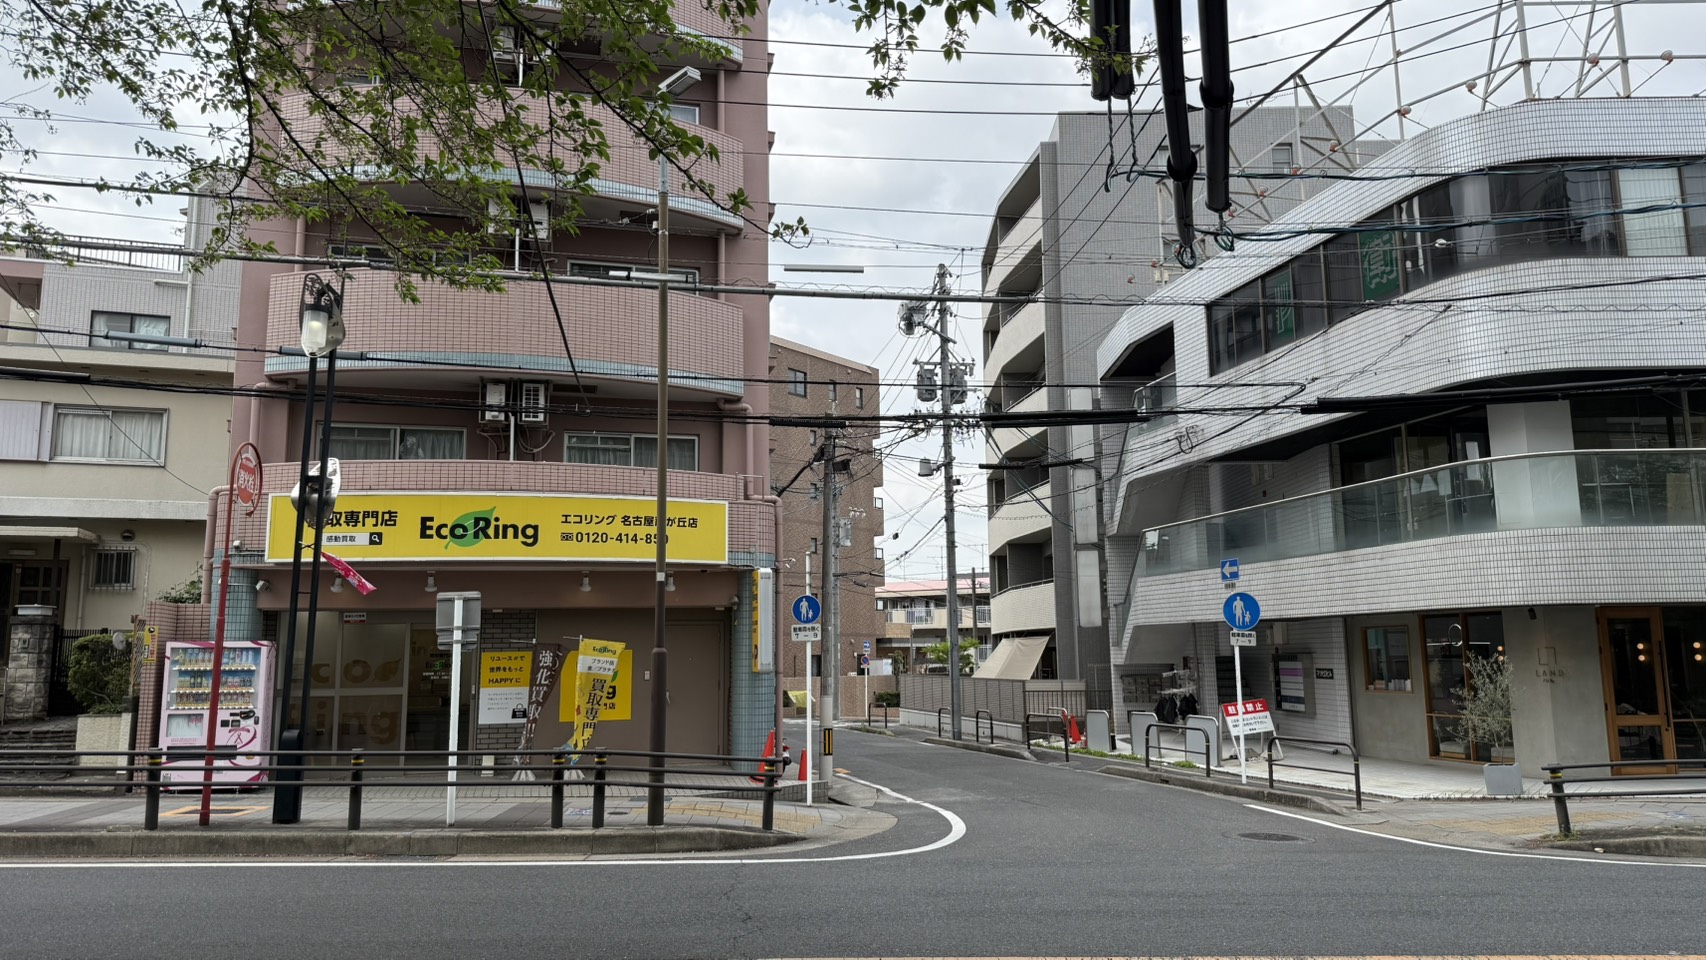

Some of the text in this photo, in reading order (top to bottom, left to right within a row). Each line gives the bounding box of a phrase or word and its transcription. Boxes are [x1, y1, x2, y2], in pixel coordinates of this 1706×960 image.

[327, 510, 398, 527] 取専門店
[560, 514, 698, 528] エコリング 名古屋が丘店
[325, 535, 356, 543] 感動買取
